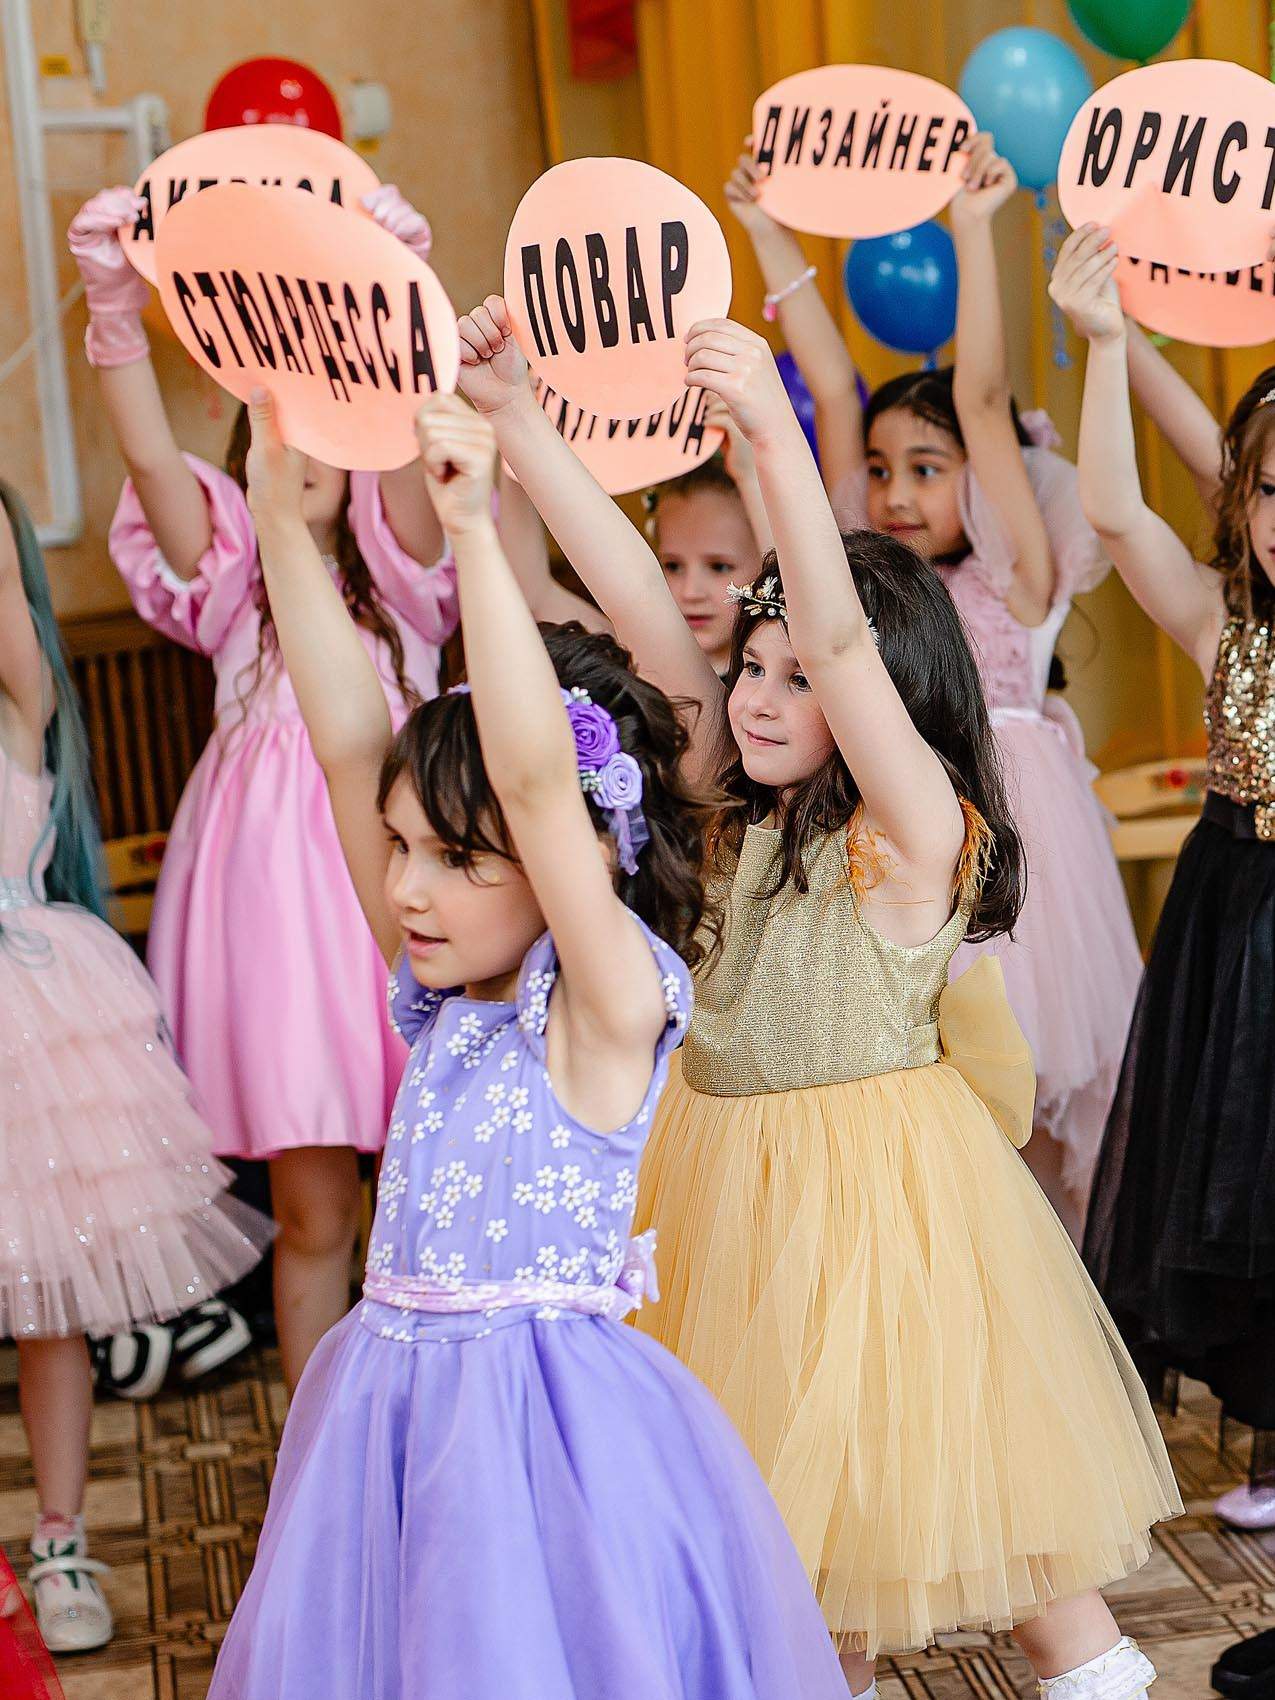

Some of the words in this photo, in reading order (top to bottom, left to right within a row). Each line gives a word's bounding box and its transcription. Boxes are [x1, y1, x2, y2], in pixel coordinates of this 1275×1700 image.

[757, 98, 970, 176] ДИЗАЙНЕР
[173, 270, 438, 403] СТЮАРДЕССА
[520, 220, 689, 358] ПОВАР
